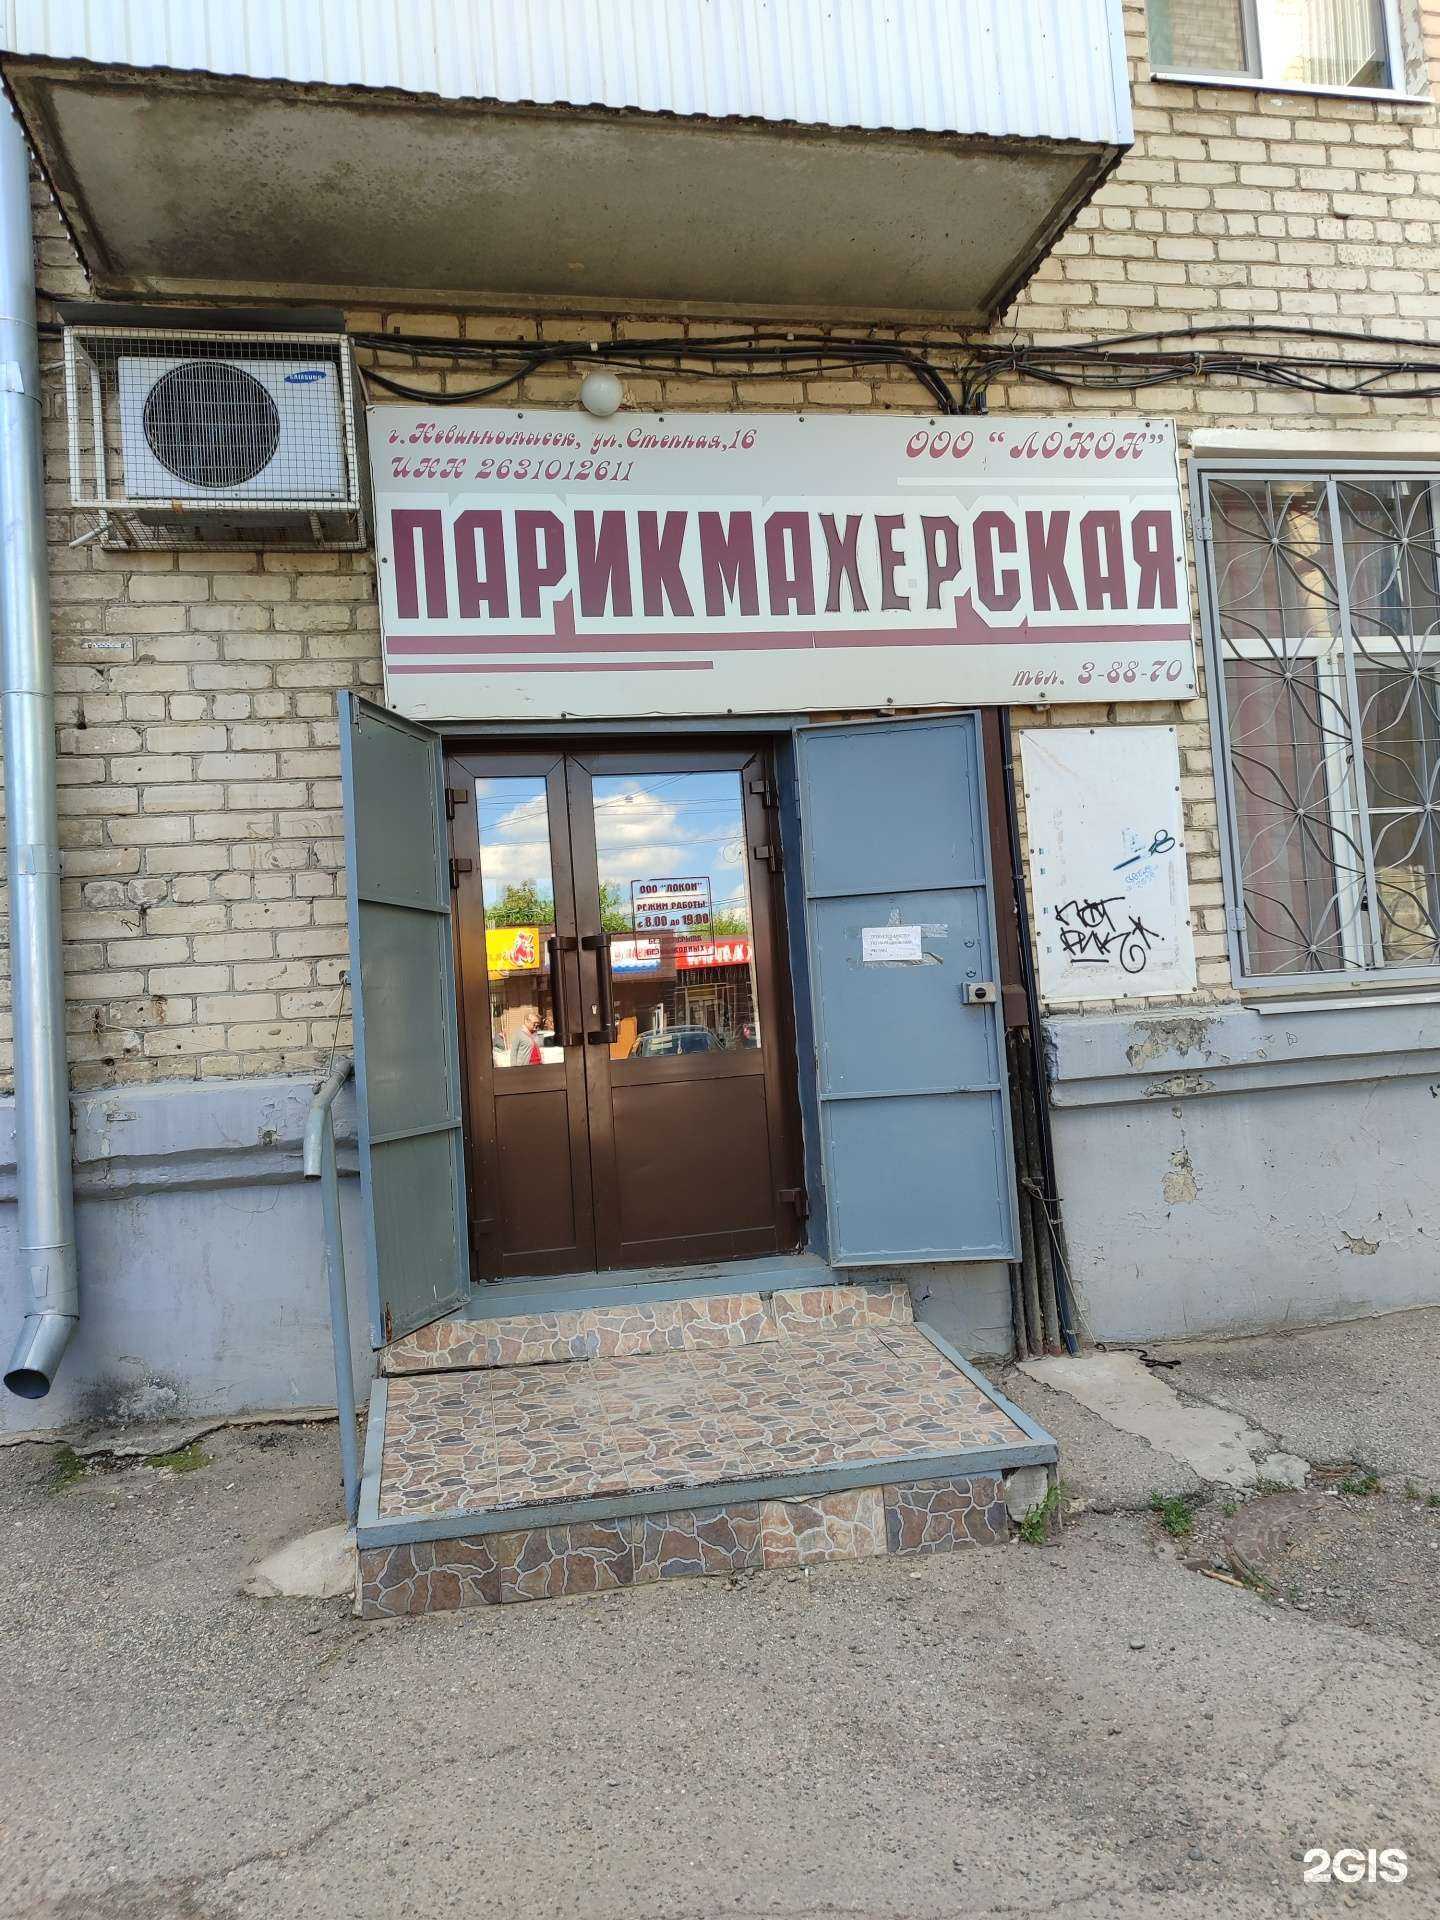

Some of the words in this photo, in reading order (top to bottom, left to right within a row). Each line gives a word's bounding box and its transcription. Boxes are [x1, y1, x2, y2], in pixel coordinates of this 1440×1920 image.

[906, 430, 975, 459] ООО
[391, 456, 467, 480] ИНН
[474, 458, 635, 481] 2631012611
[391, 509, 1178, 618] ПАРИКМАХЕРСКАЯ
[1012, 668, 1065, 687] тел.
[1077, 659, 1183, 685] 3-88-70
[640, 885, 657, 893] ООО
[637, 902, 668, 911] РЕЖИМ
[645, 916, 667, 927] 8.00
